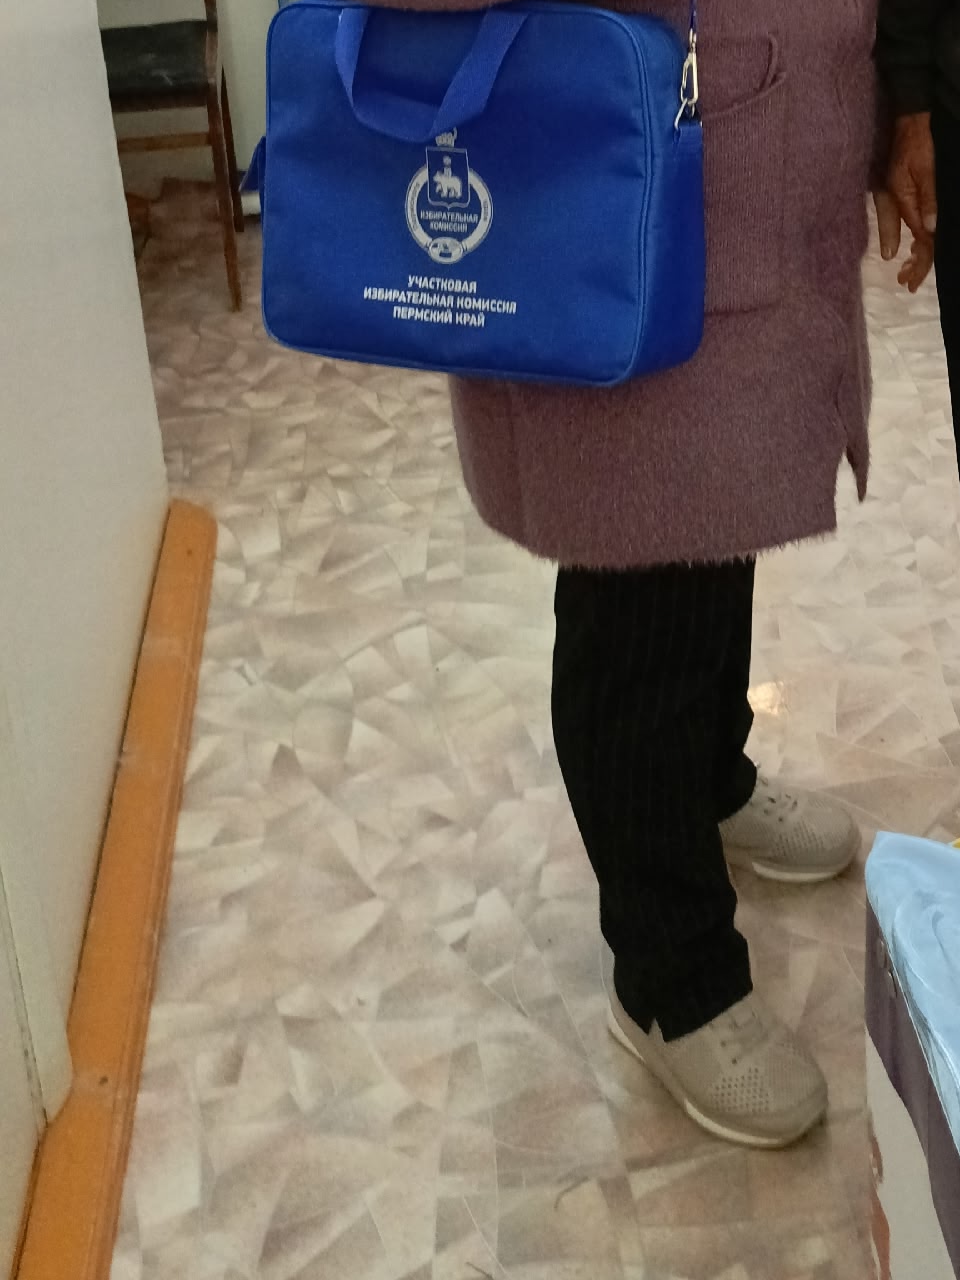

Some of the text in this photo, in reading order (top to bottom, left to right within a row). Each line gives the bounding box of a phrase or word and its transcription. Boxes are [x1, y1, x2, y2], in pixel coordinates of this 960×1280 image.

[420, 210, 479, 224] ИЗБИРАТЕЛЬНАЯ
[408, 274, 477, 294] УЧАСТКОВАЯ
[363, 286, 517, 315] ИЗБИРАТЕЛЬНАЯ КОМИССИЯ
[393, 305, 486, 328] ПЕРМСКИЙ КРАЙ
